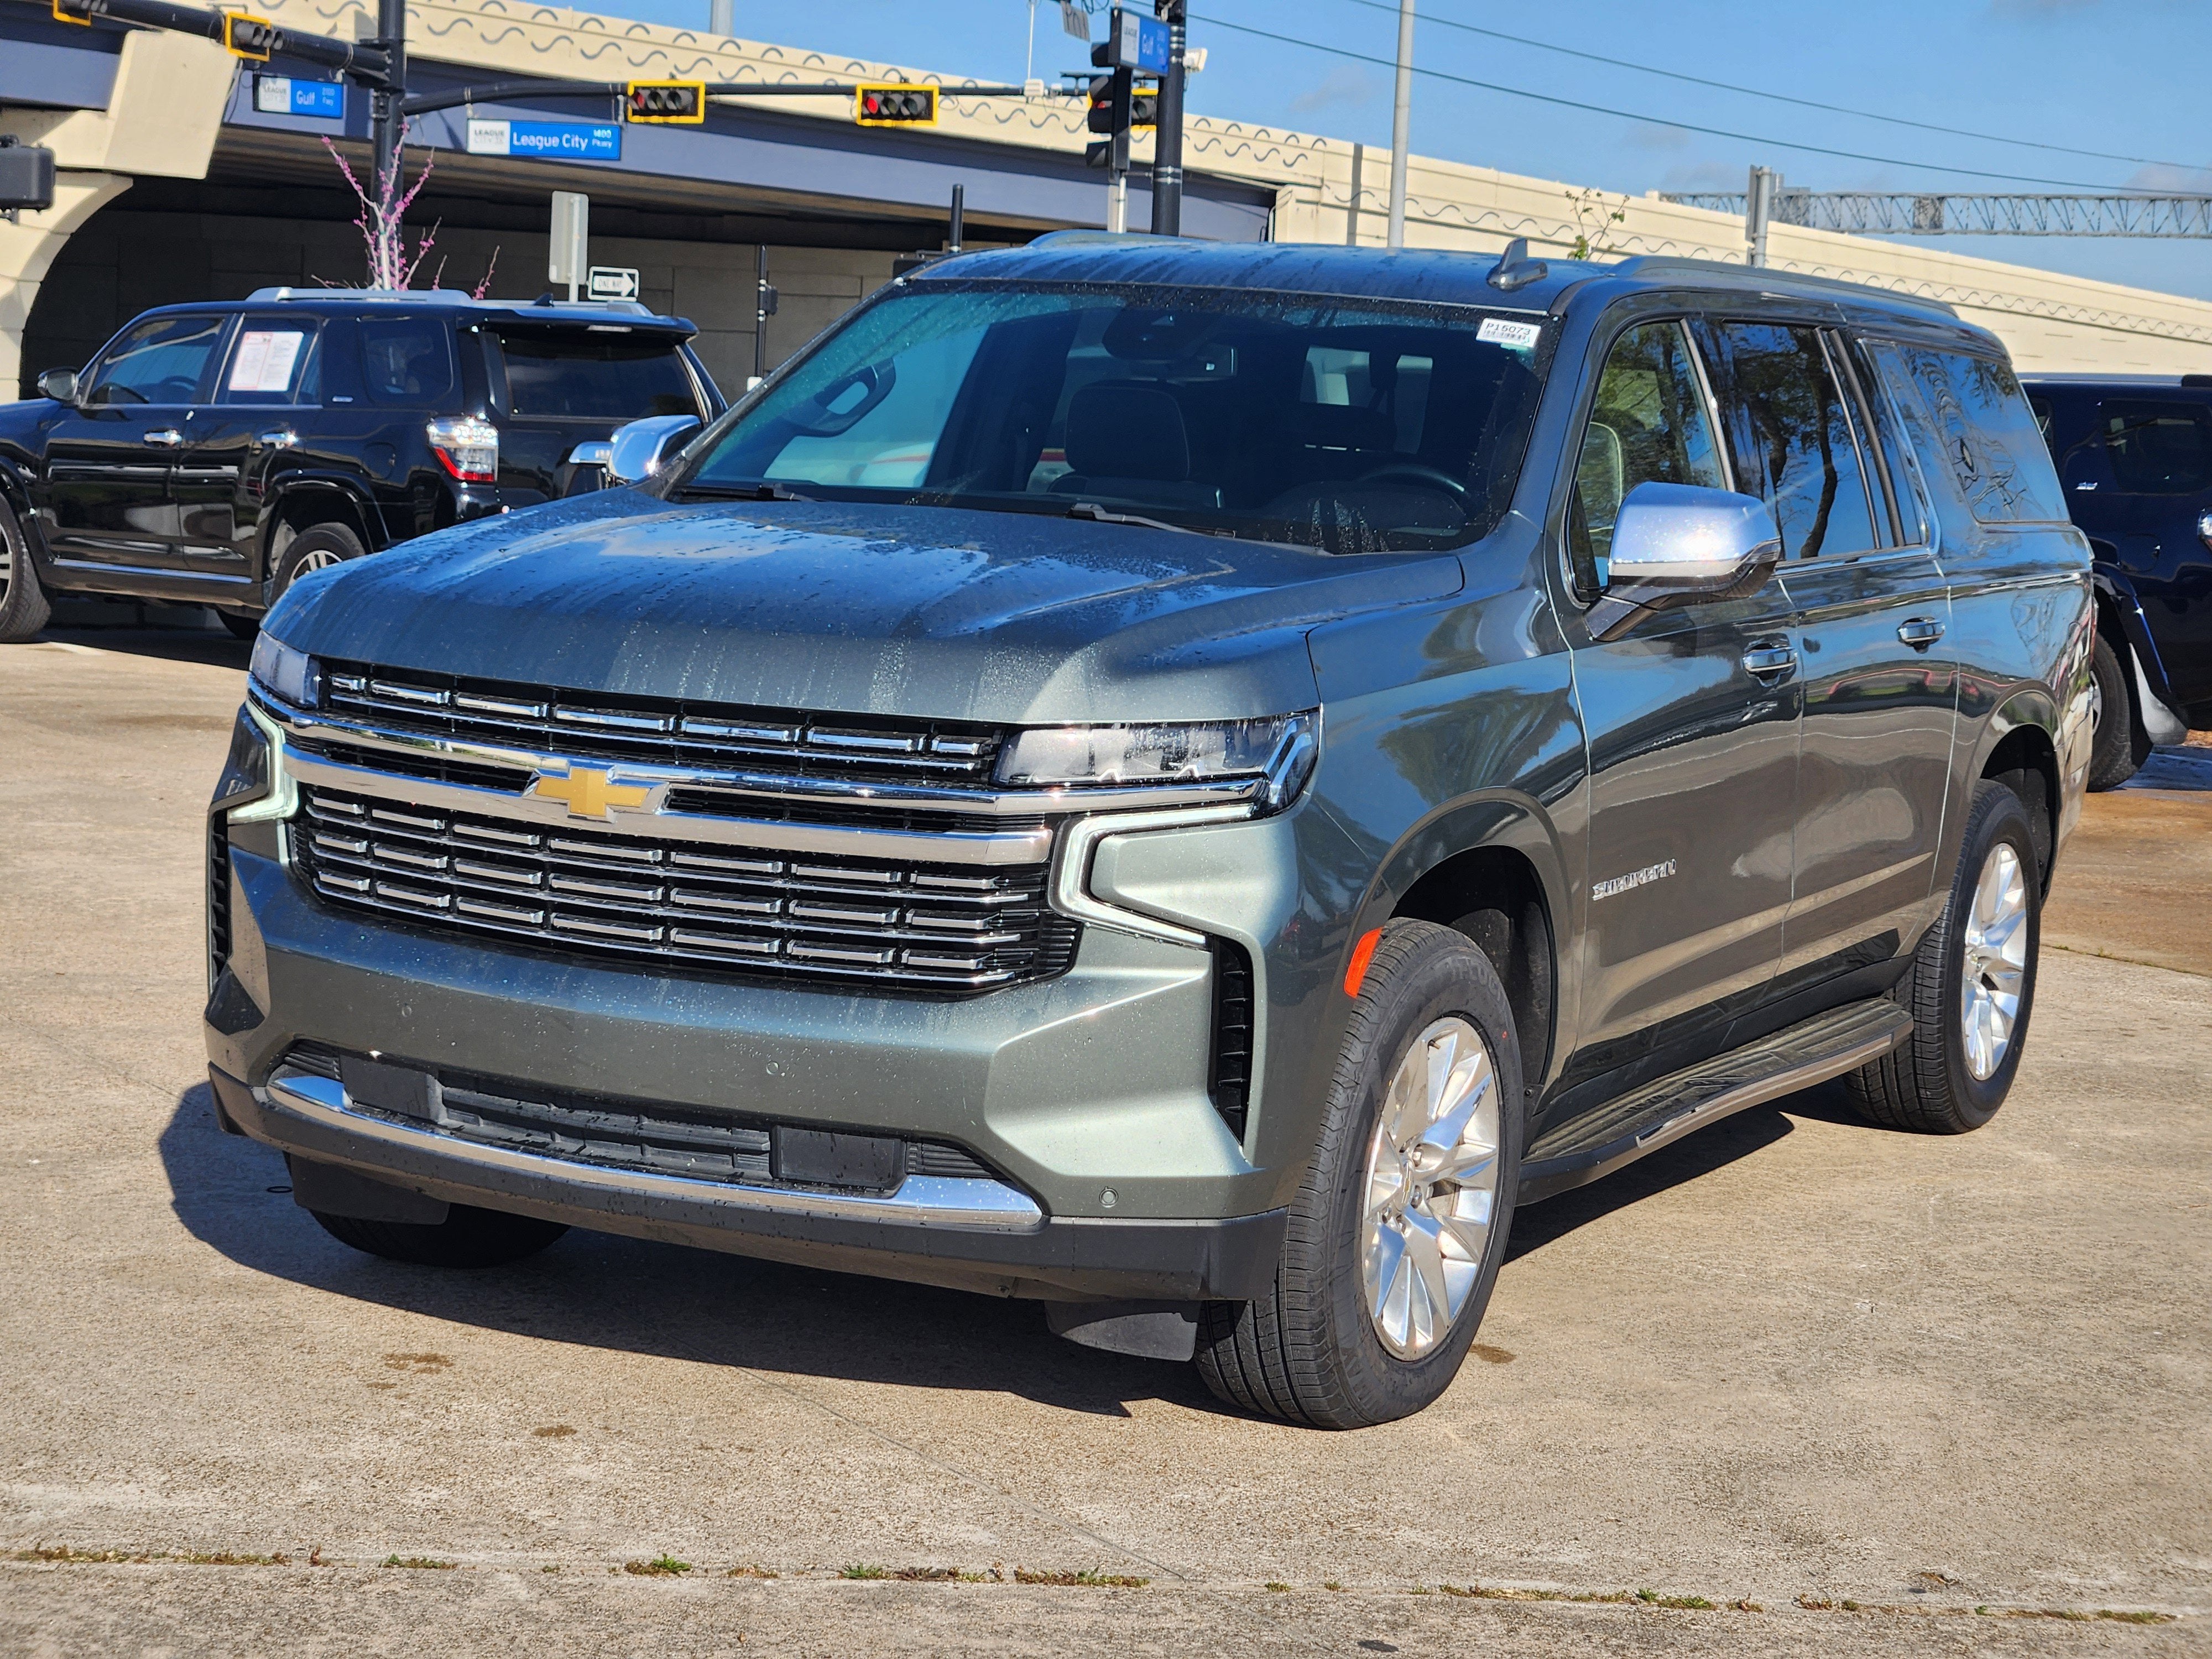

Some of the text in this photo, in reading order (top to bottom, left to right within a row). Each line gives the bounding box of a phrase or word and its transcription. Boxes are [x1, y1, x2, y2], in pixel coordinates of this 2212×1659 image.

[296, 90, 316, 106] Gulf
[513, 132, 560, 150] League
[562, 133, 588, 151] City
